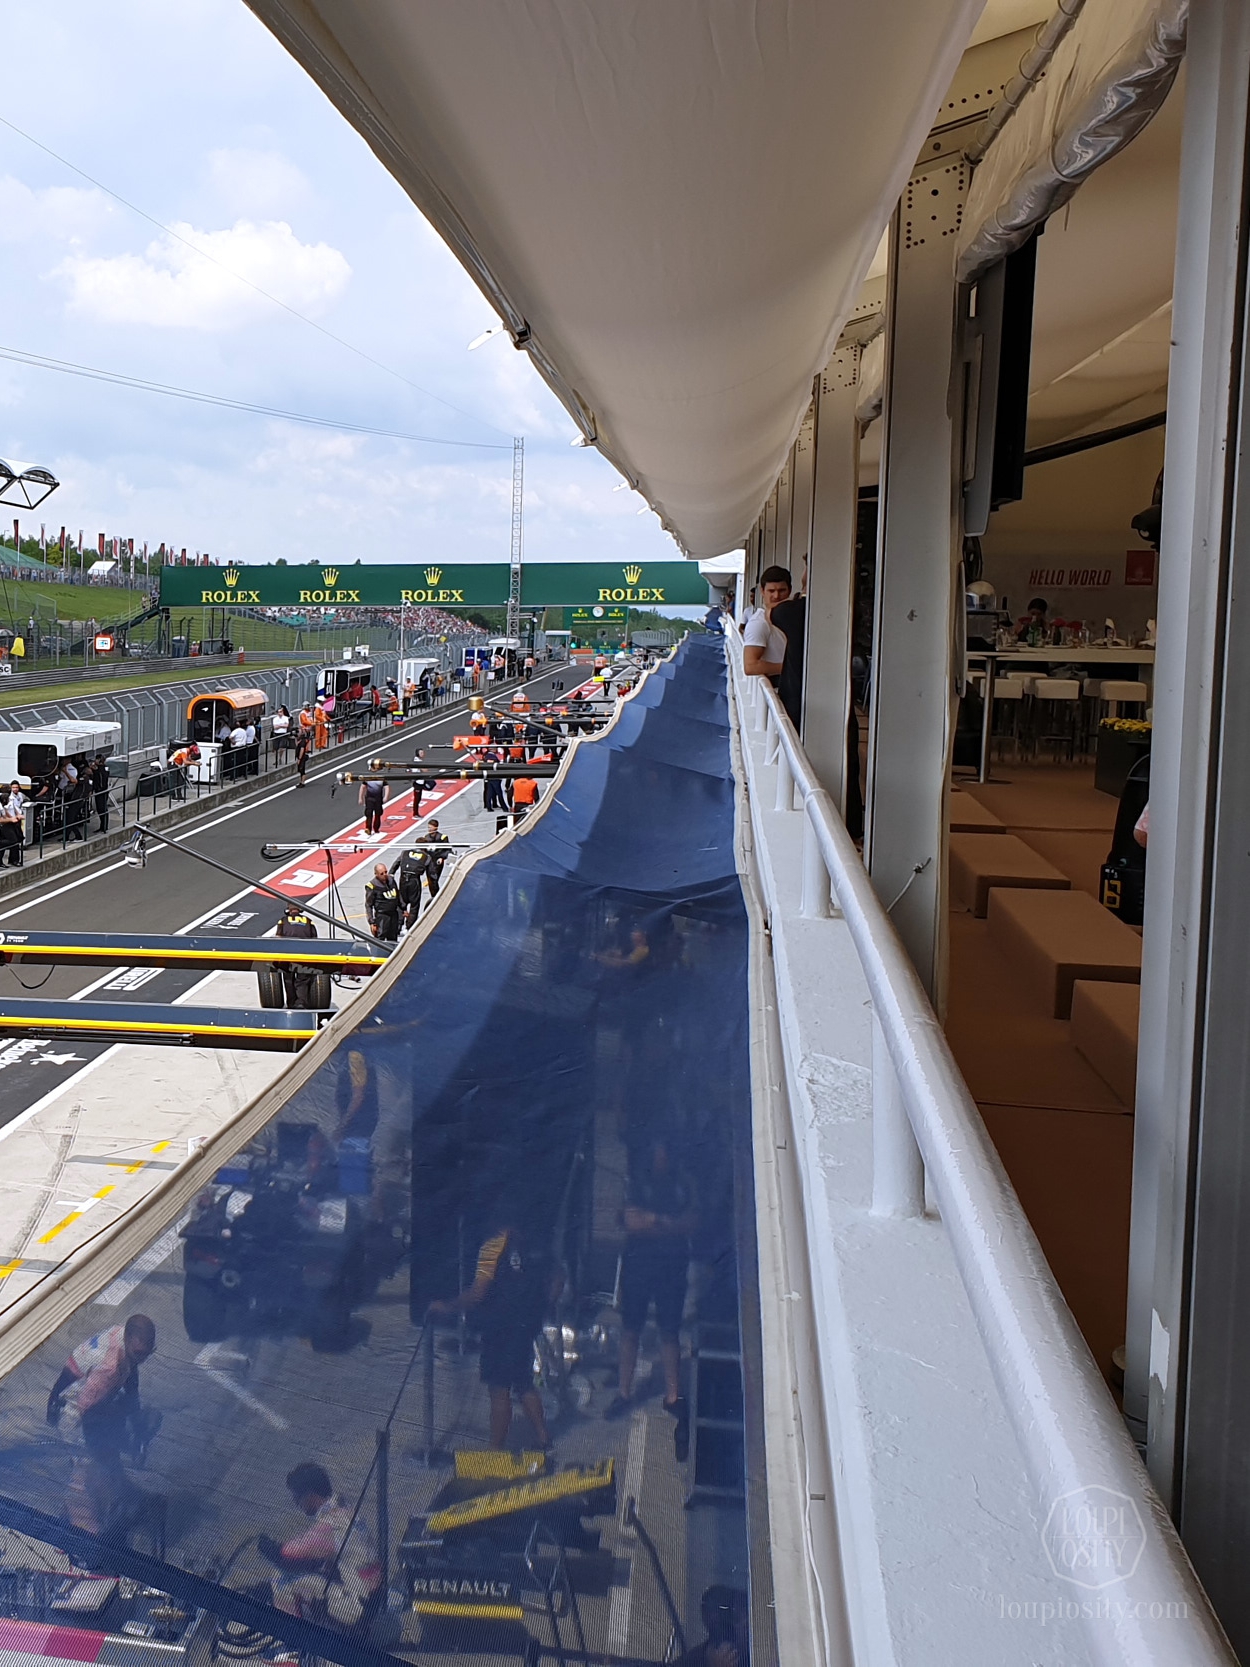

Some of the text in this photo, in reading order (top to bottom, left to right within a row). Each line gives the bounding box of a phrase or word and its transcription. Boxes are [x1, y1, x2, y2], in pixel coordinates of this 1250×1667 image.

[1029, 569, 1112, 586] HELLO WORLD
[201, 590, 260, 603] ROLEX
[299, 590, 361, 602] ROLEX
[400, 590, 464, 602] ROLEX
[597, 588, 665, 602] ROLEX
[413, 1577, 511, 1598] RENAULT
